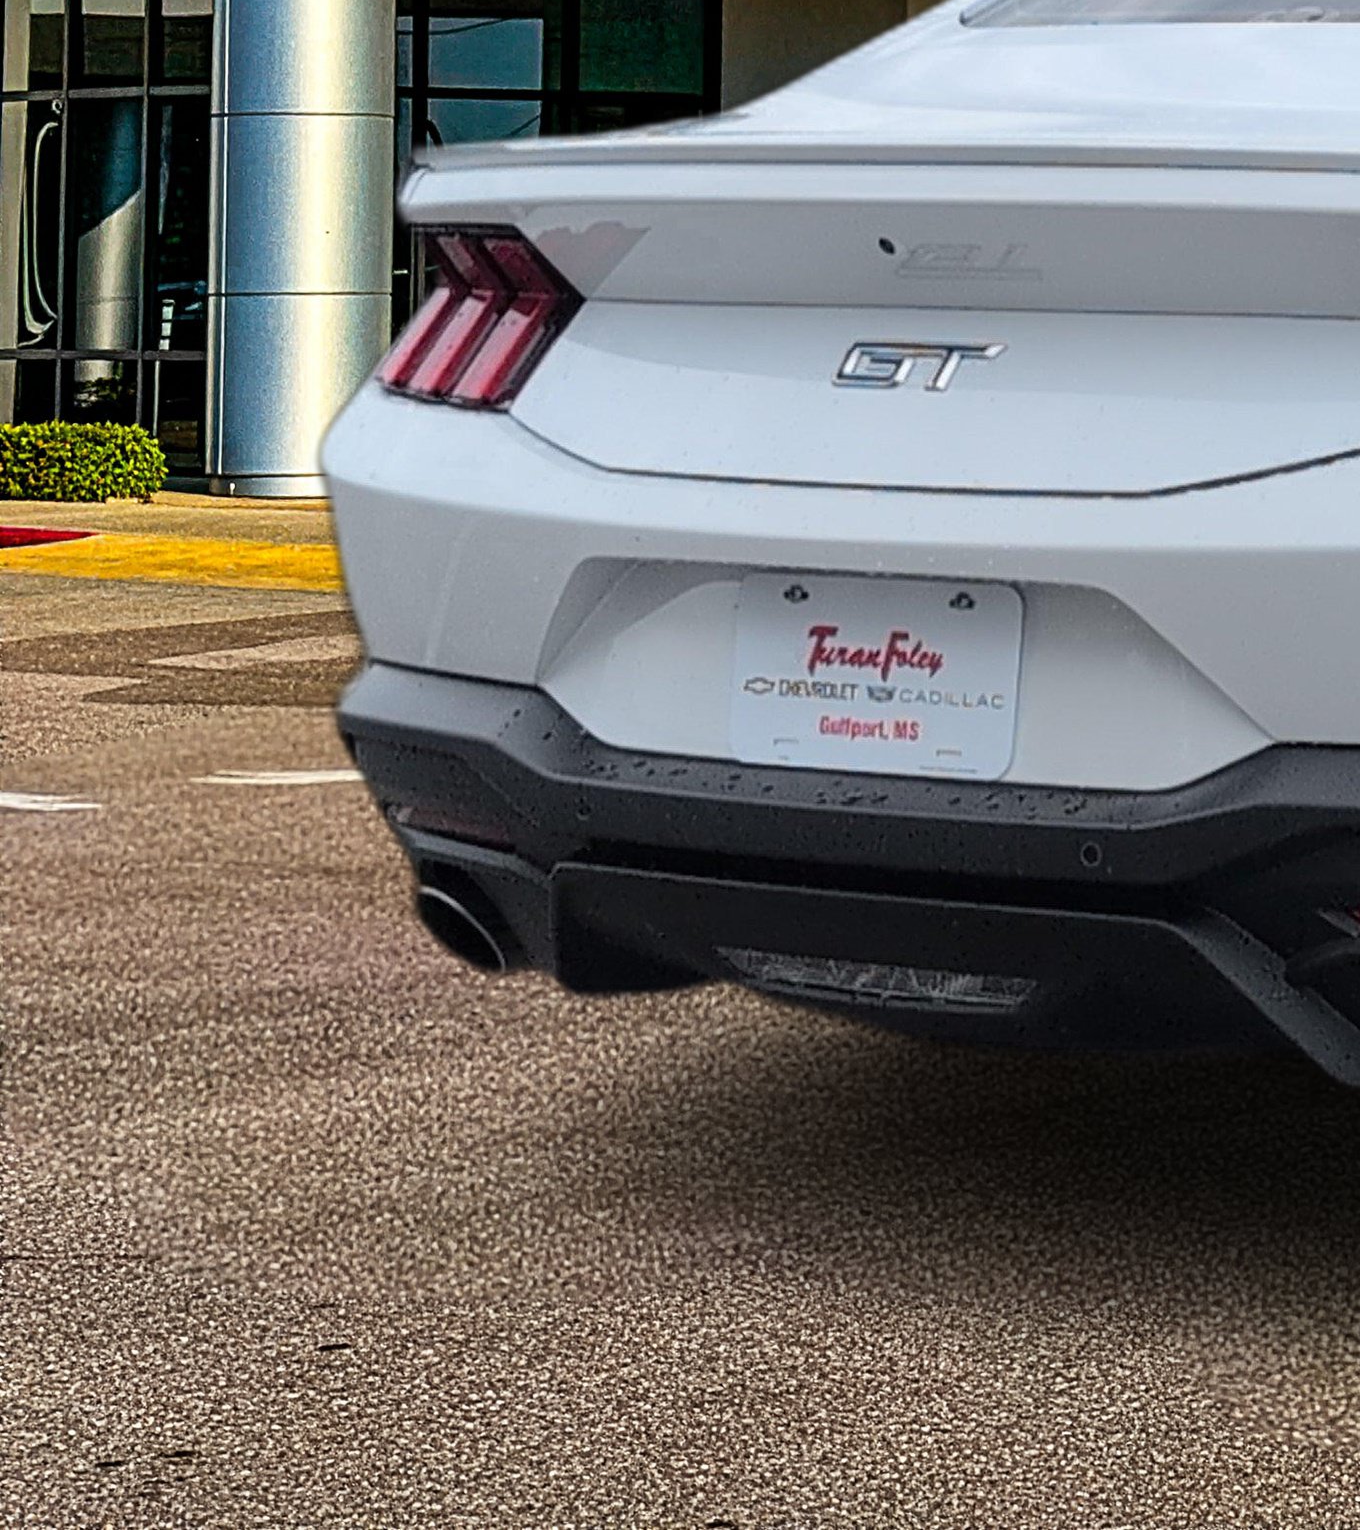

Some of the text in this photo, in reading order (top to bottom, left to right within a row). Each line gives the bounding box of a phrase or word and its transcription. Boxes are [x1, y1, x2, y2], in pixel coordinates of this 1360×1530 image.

[832, 341, 1008, 391] GT
[778, 677, 1006, 710] CHEVROLET CADILLAC
[893, 719, 921, 742] MS
